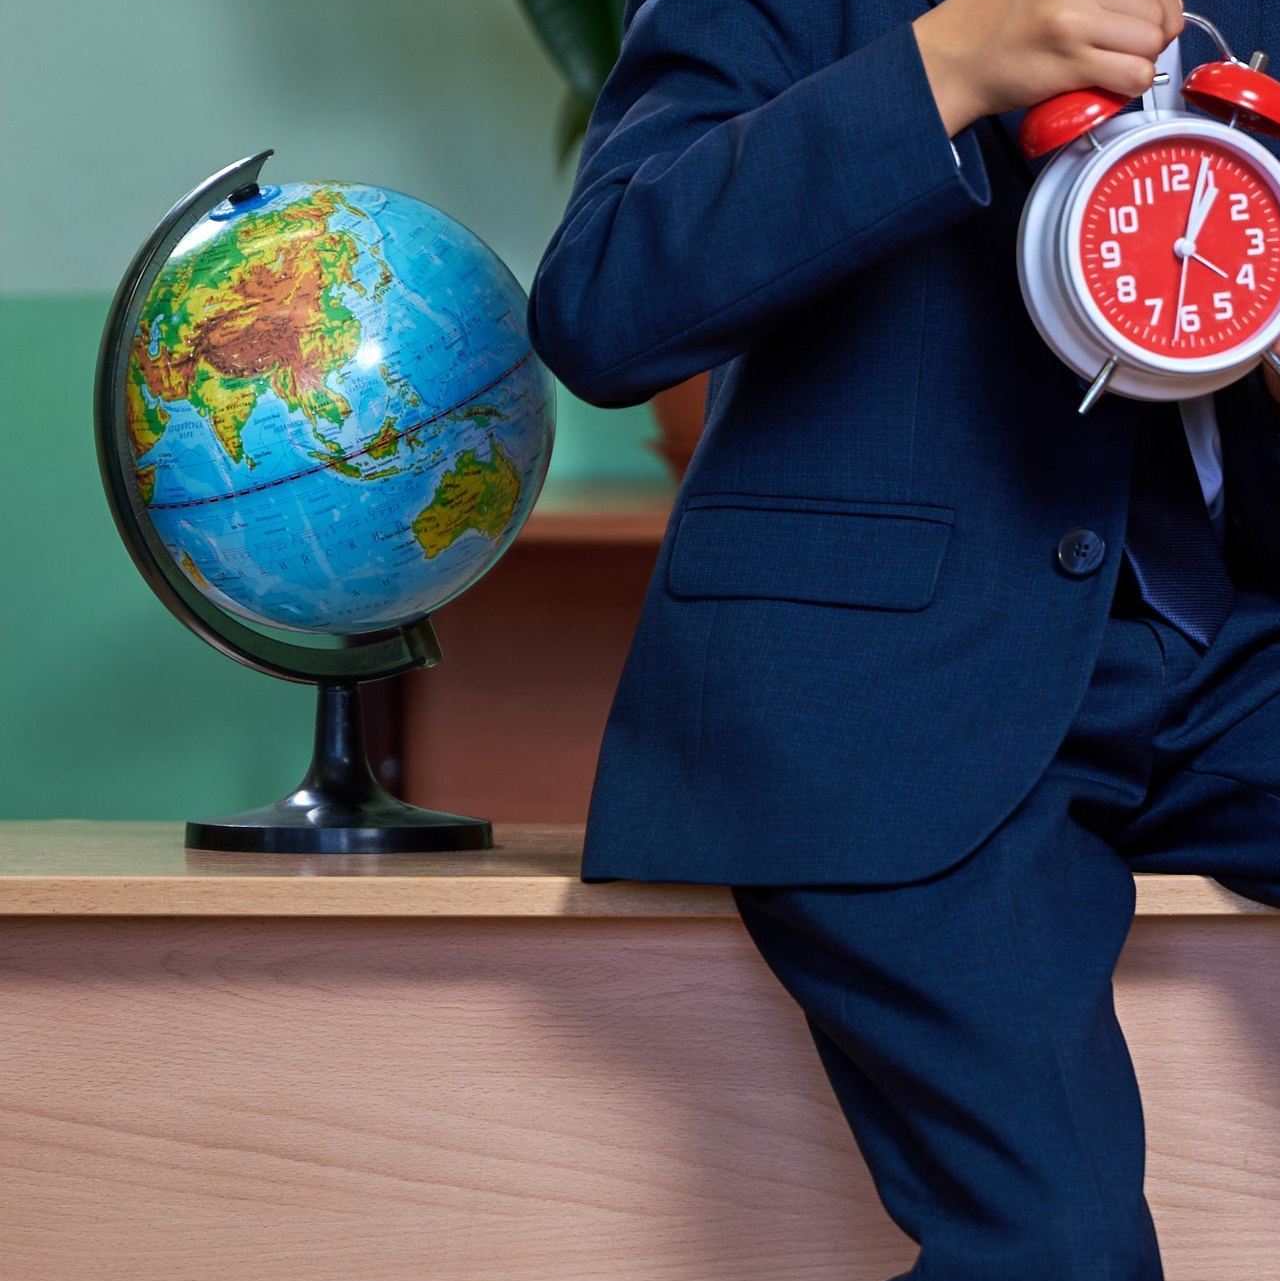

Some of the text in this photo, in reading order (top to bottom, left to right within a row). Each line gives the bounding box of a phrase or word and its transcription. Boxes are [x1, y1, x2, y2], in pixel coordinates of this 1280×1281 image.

[1132, 177, 1154, 206] 11
[1161, 163, 1191, 192] 12
[1108, 205, 1139, 235] 10
[1229, 193, 1250, 221] 2
[1100, 240, 1121, 269] 9
[1244, 227, 1265, 256] 3
[1116, 275, 1137, 303] 8
[1235, 263, 1256, 291] 4
[1144, 298, 1163, 326] 7
[1180, 304, 1201, 333] 6
[1213, 291, 1234, 320] 5
